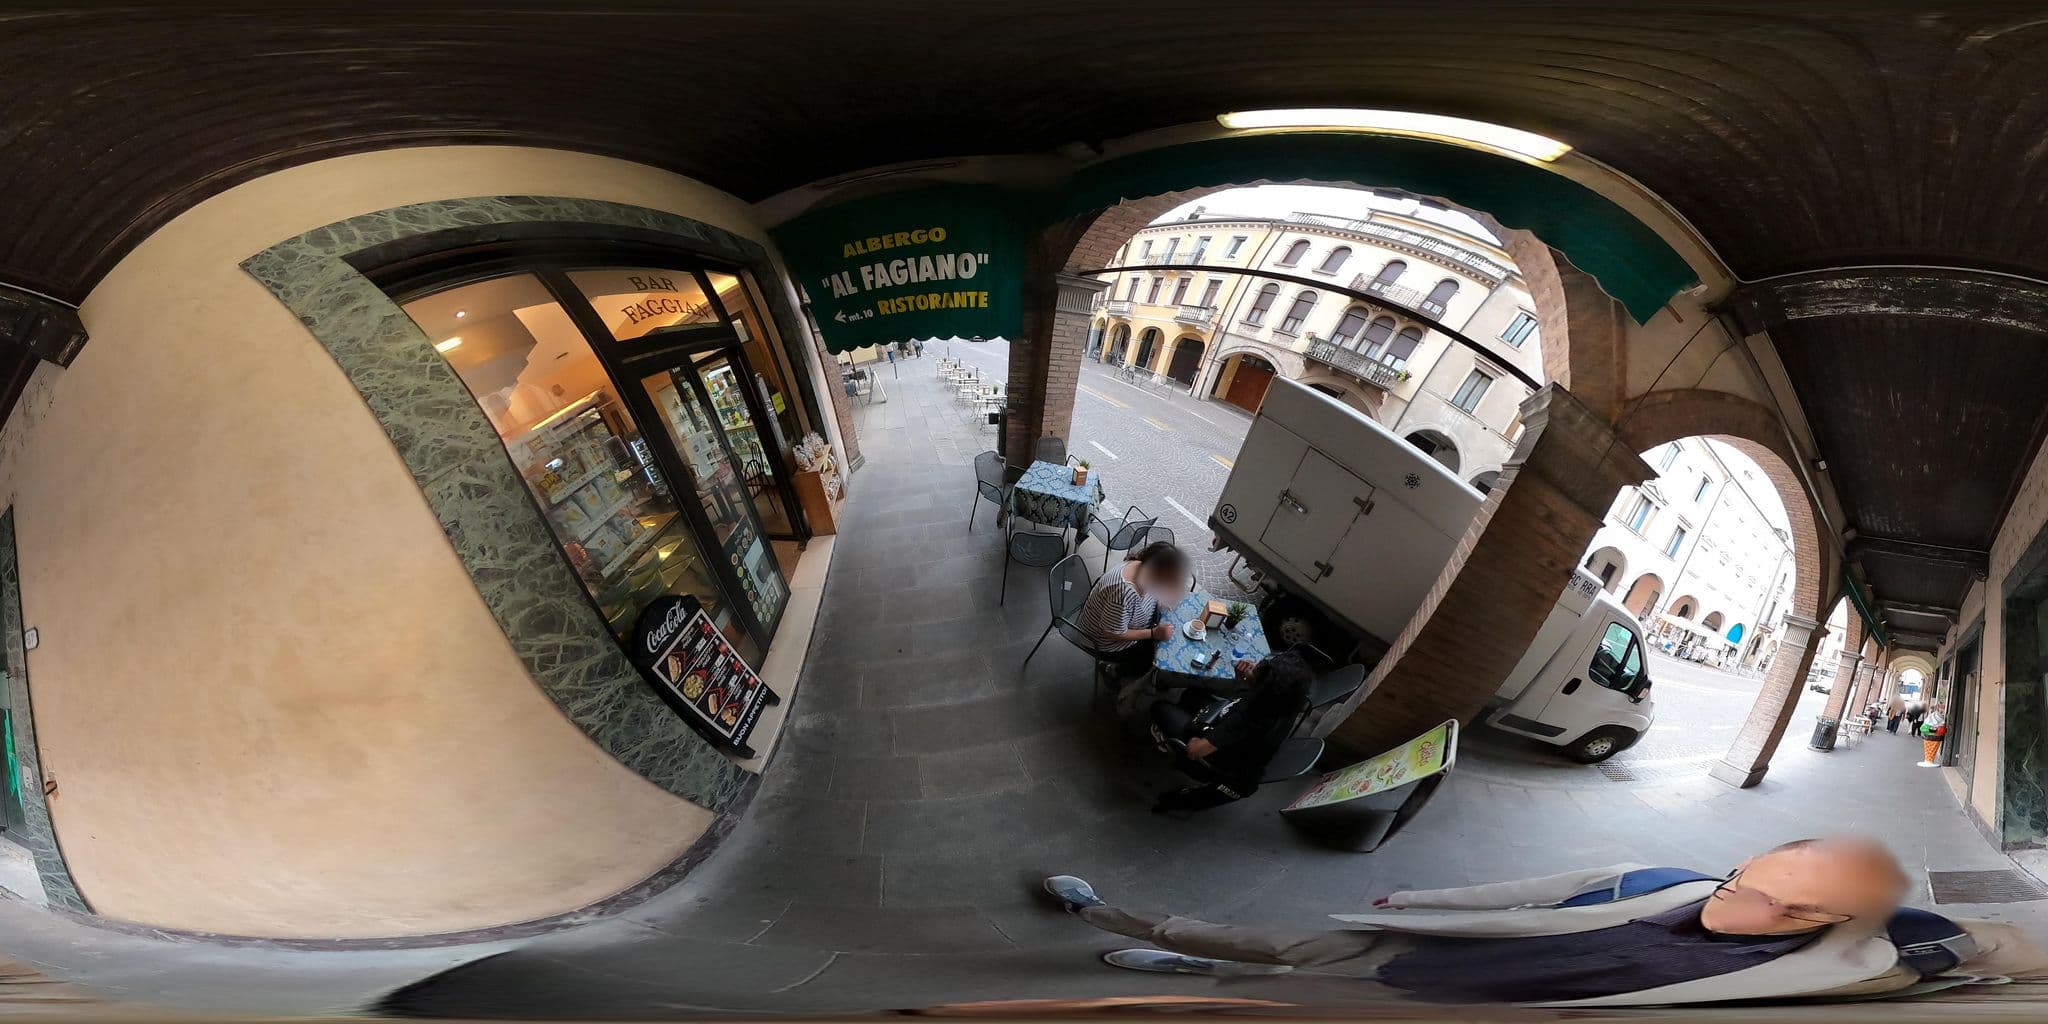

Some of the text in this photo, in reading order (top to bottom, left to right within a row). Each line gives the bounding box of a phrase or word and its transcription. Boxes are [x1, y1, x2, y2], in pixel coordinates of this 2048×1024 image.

[843, 227, 947, 259] ALBERGO
[628, 275, 678, 293] BAR
[821, 252, 989, 300] "AL FAGIANO"
[621, 298, 710, 325] FAGGIAN
[877, 291, 989, 316] RISTORANTE
[1223, 508, 1235, 521] 42
[646, 600, 688, 654] Coca-Cola
[733, 723, 748, 746] BUON
[747, 686, 768, 724] APPETITO!
